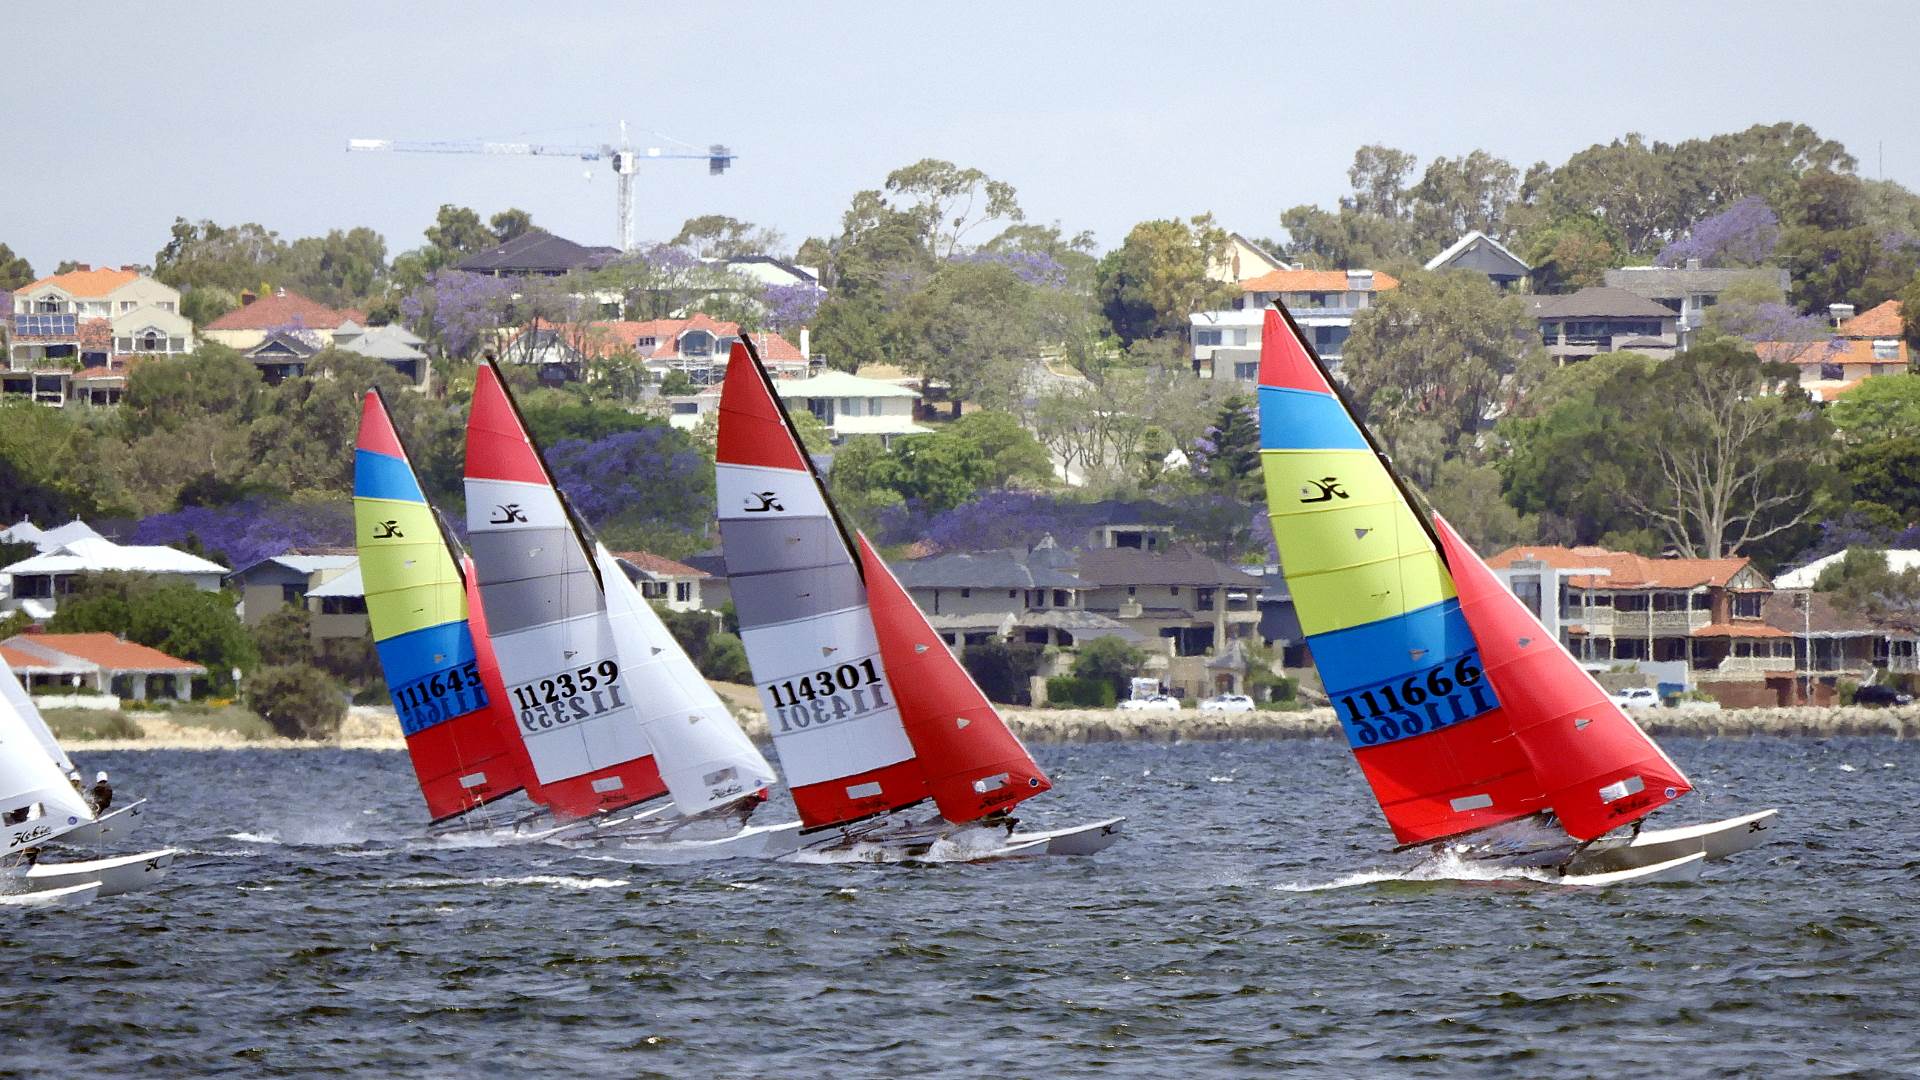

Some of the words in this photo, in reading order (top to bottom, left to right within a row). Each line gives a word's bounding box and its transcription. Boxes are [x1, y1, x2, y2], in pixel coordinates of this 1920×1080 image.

[397, 662, 481, 714] 111645
[514, 661, 619, 710] 112359
[768, 659, 881, 708] 114301
[1341, 656, 1481, 721] 111666
[10, 825, 53, 847] Hobie
